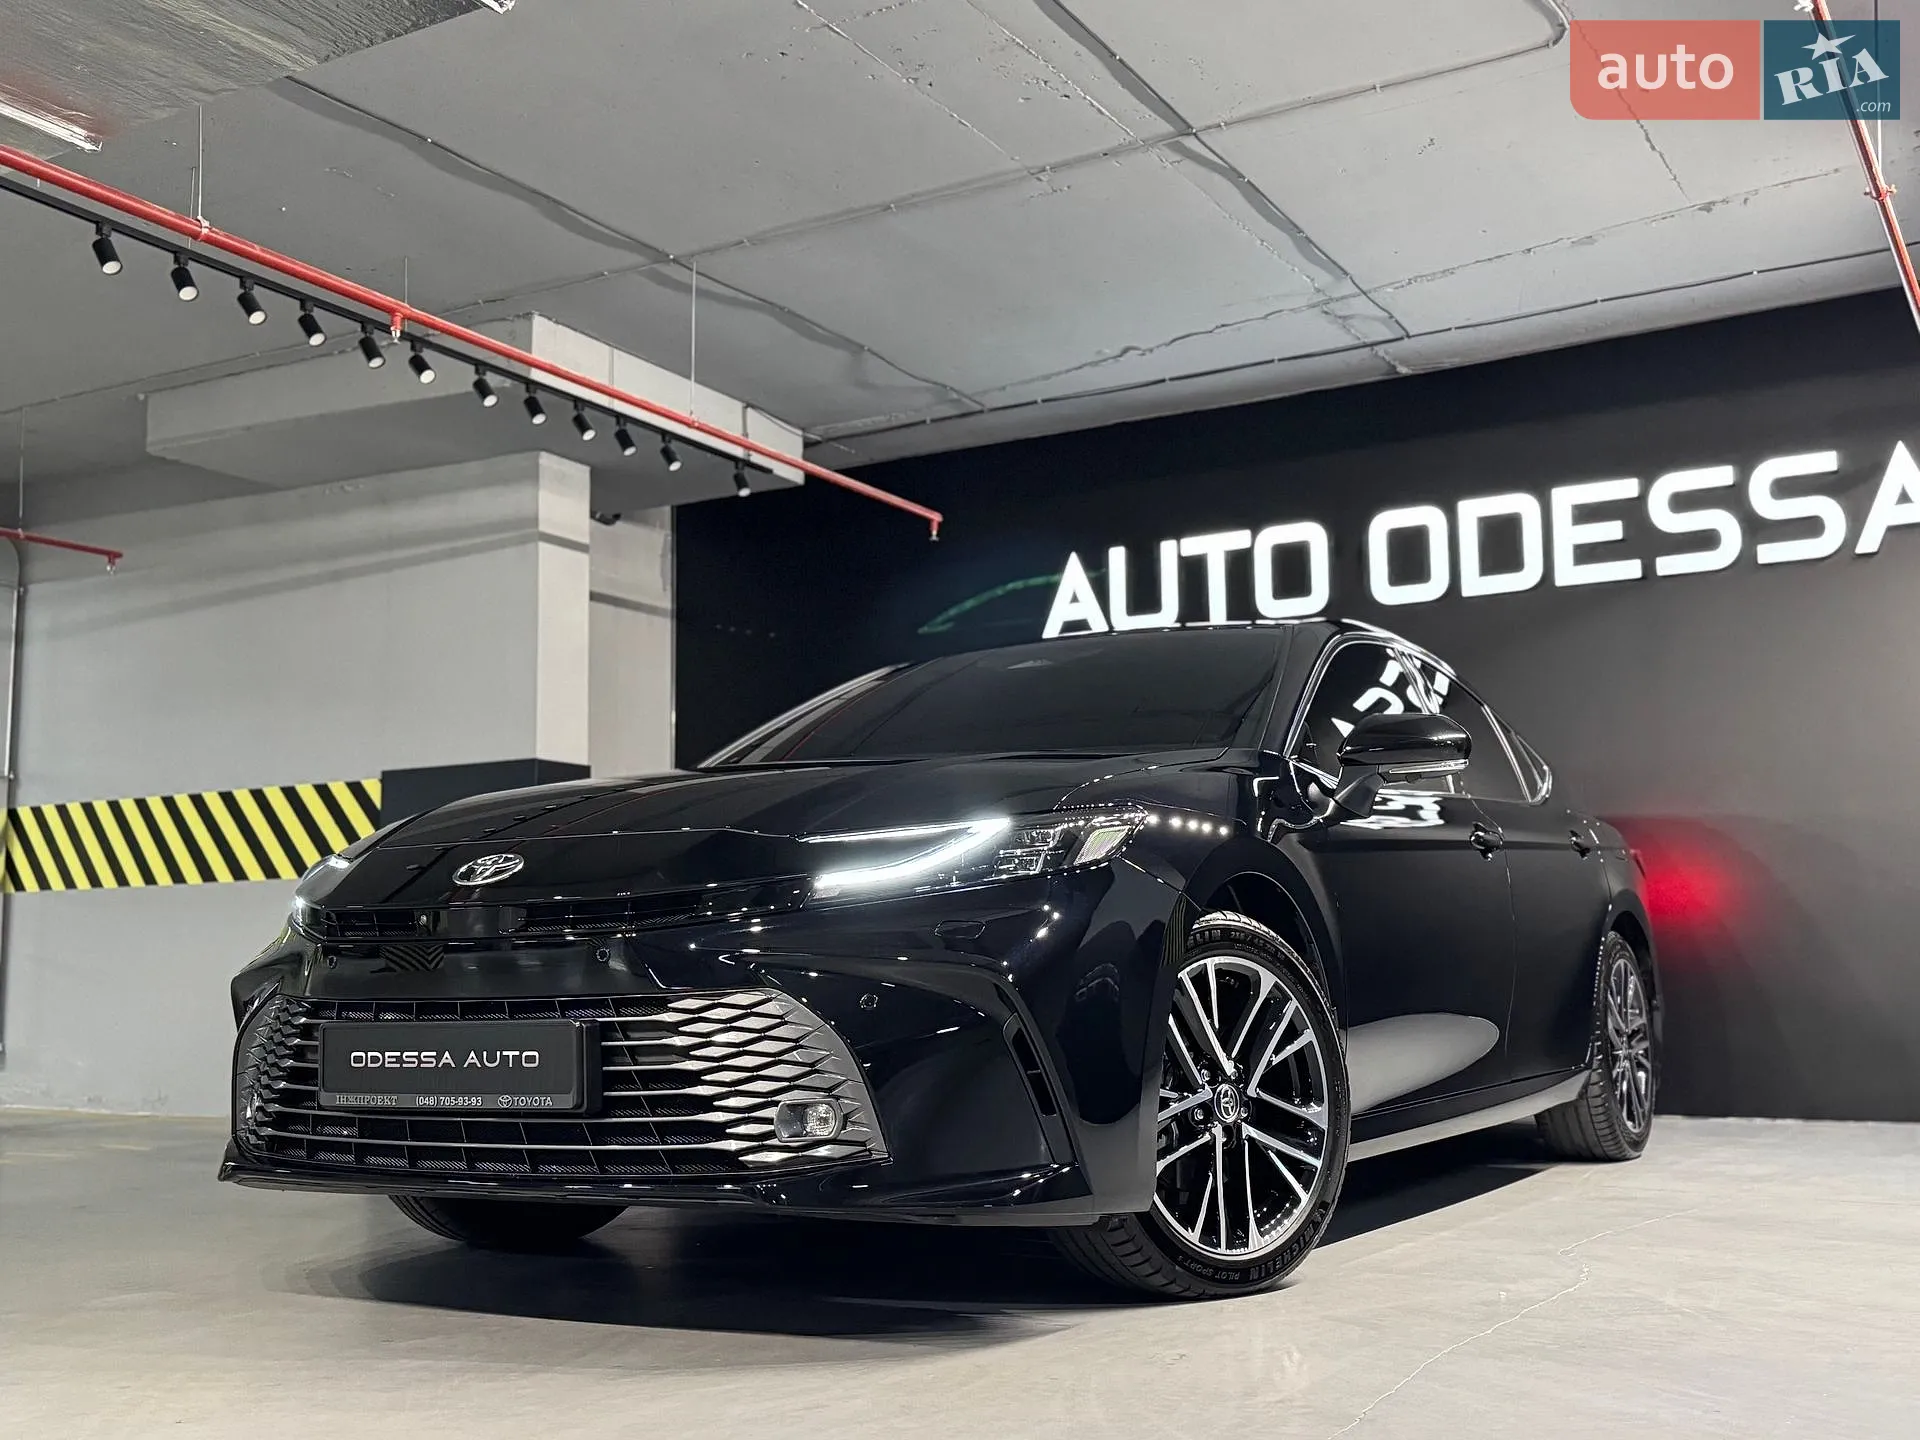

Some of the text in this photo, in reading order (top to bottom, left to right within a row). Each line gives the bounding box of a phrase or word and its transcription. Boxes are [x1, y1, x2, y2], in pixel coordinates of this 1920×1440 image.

[1042, 440, 1920, 639] AUTO ODESSA
[350, 1050, 540, 1068] ODESSA AUTO
[415, 1095, 482, 1107] (048) 705-93-93
[513, 1096, 553, 1108] TOYOTA
[1249, 1223, 1315, 1281] MICHELIN
